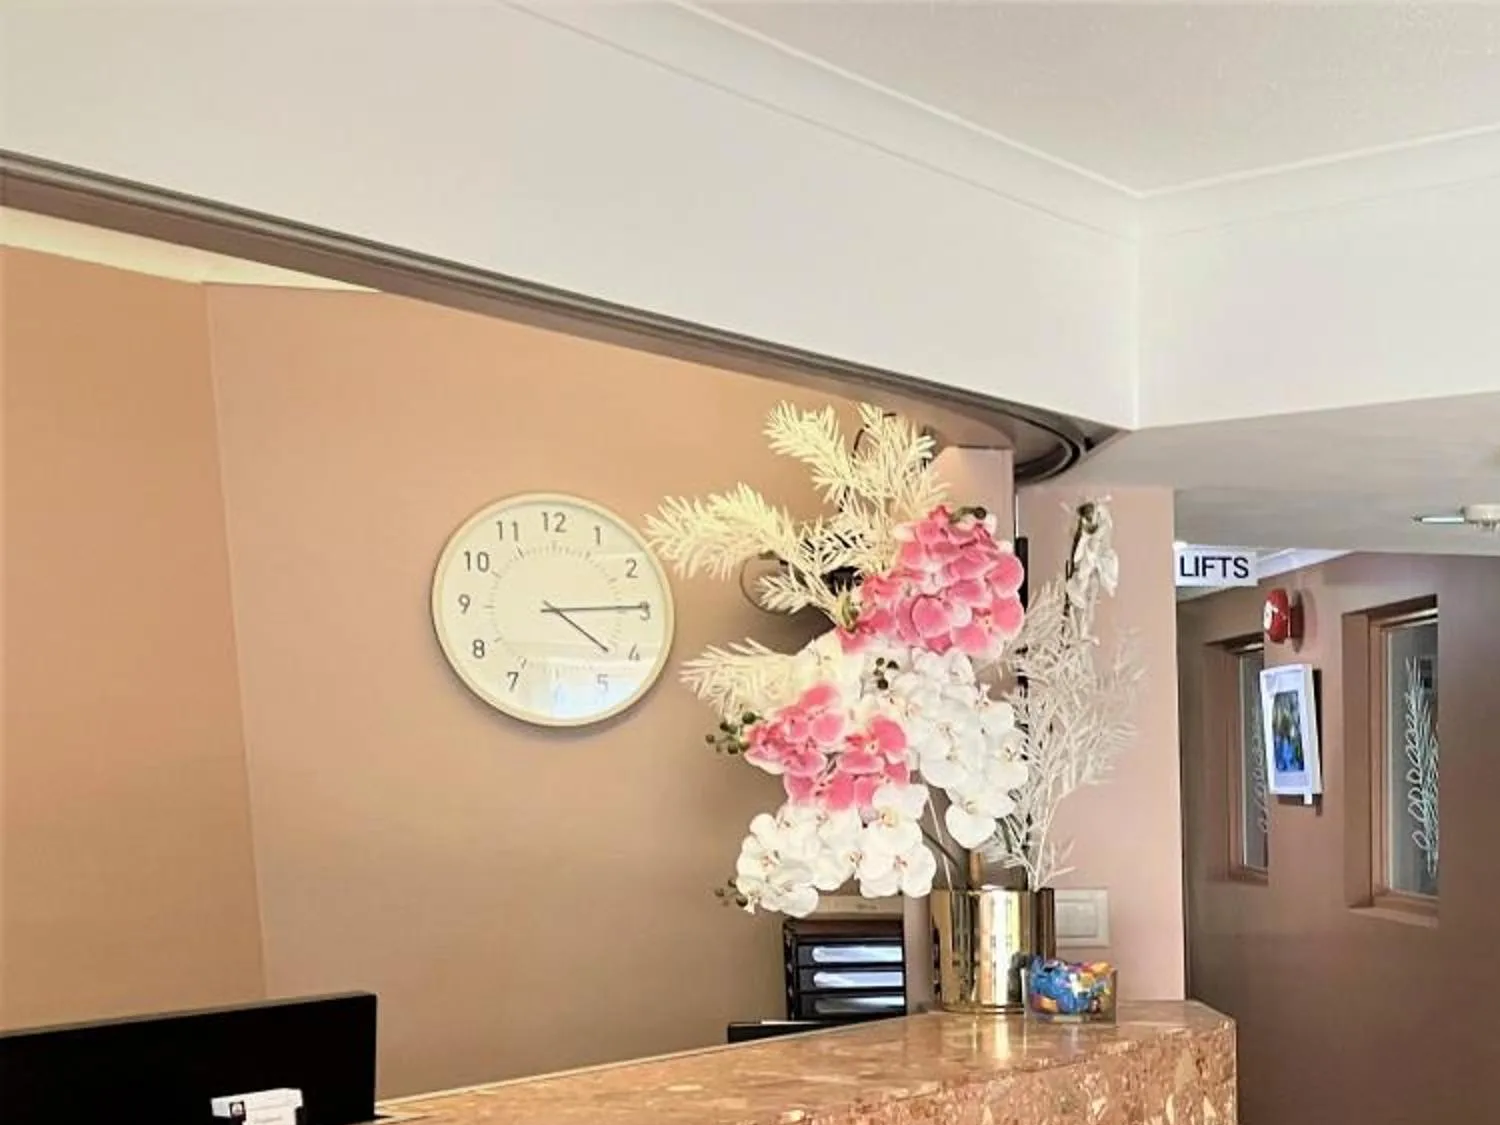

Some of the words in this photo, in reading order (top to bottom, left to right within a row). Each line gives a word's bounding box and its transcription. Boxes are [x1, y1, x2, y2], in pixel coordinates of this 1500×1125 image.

[496, 520, 519, 542] 11
[541, 511, 567, 533] 12
[594, 526, 601, 545] 1
[463, 551, 490, 572] 10
[625, 558, 638, 579] 2
[1179, 555, 1249, 578] LIFTS
[458, 594, 471, 614] 9
[639, 601, 651, 621] 3
[472, 639, 485, 659] 8
[628, 645, 641, 662] 4
[507, 671, 519, 692] 7
[597, 674, 609, 693] 5
